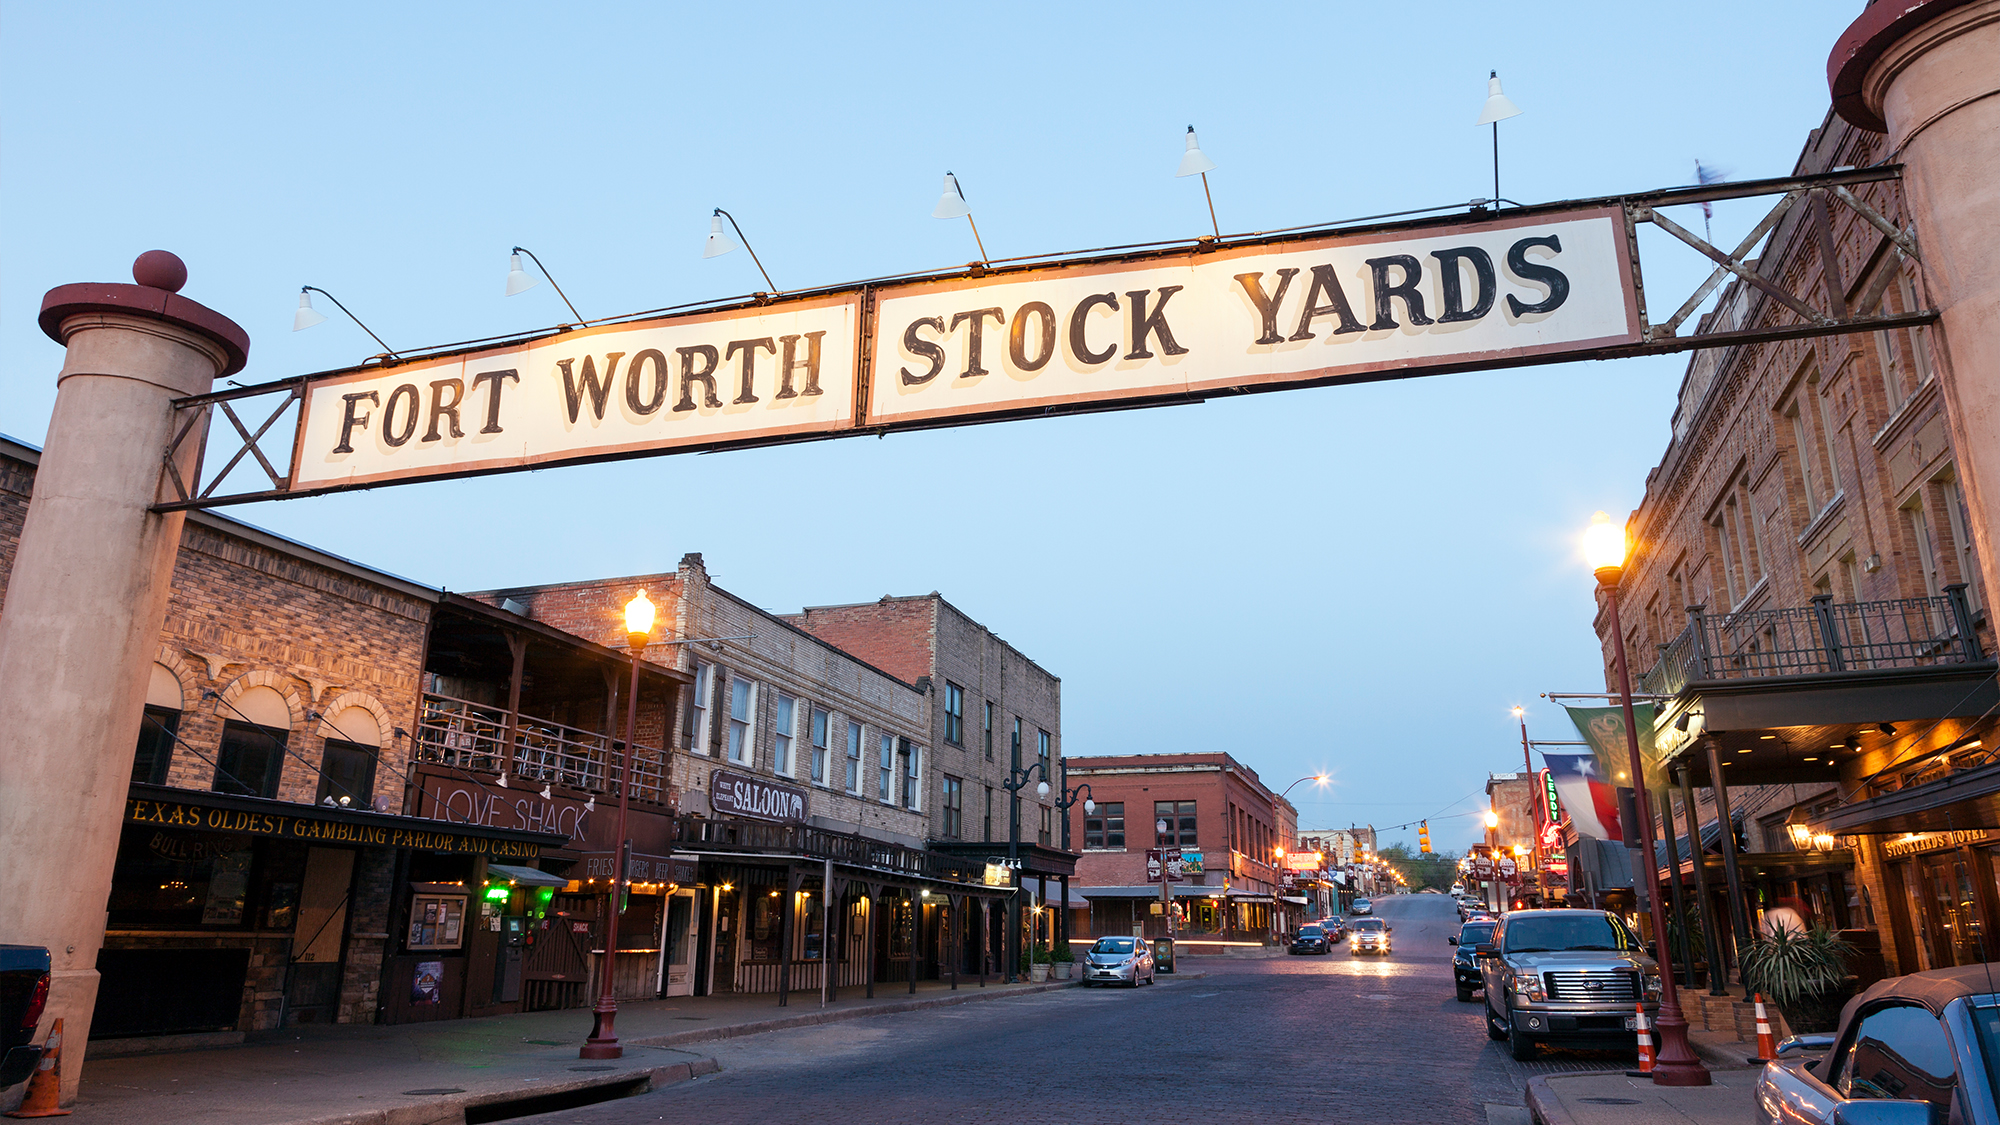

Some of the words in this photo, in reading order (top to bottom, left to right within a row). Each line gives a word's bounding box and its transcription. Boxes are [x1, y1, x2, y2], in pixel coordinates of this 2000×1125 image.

[332, 368, 520, 454] FORT
[556, 330, 827, 424] WORTH
[900, 284, 1190, 386] STOCK
[1233, 233, 1571, 345] YARDS
[719, 781, 732, 790] WHITE
[733, 780, 790, 817] SALOON
[1546, 773, 1559, 821] LEDDY
[433, 786, 504, 826] LOVE
[513, 798, 589, 842] SHACK
[149, 831, 187, 858] BULL
[208, 809, 289, 835] OLDEST
[293, 819, 388, 843] GAMBLING
[392, 829, 454, 851] PARLOR
[458, 836, 488, 854] AND
[491, 839, 539, 858] CASINO
[1886, 834, 1946, 857] STOCKYARDS
[1949, 829, 1988, 845] HOTEL
[586, 857, 615, 876] FRIES
[654, 862, 669, 880] BEER
[304, 952, 316, 961] 112
